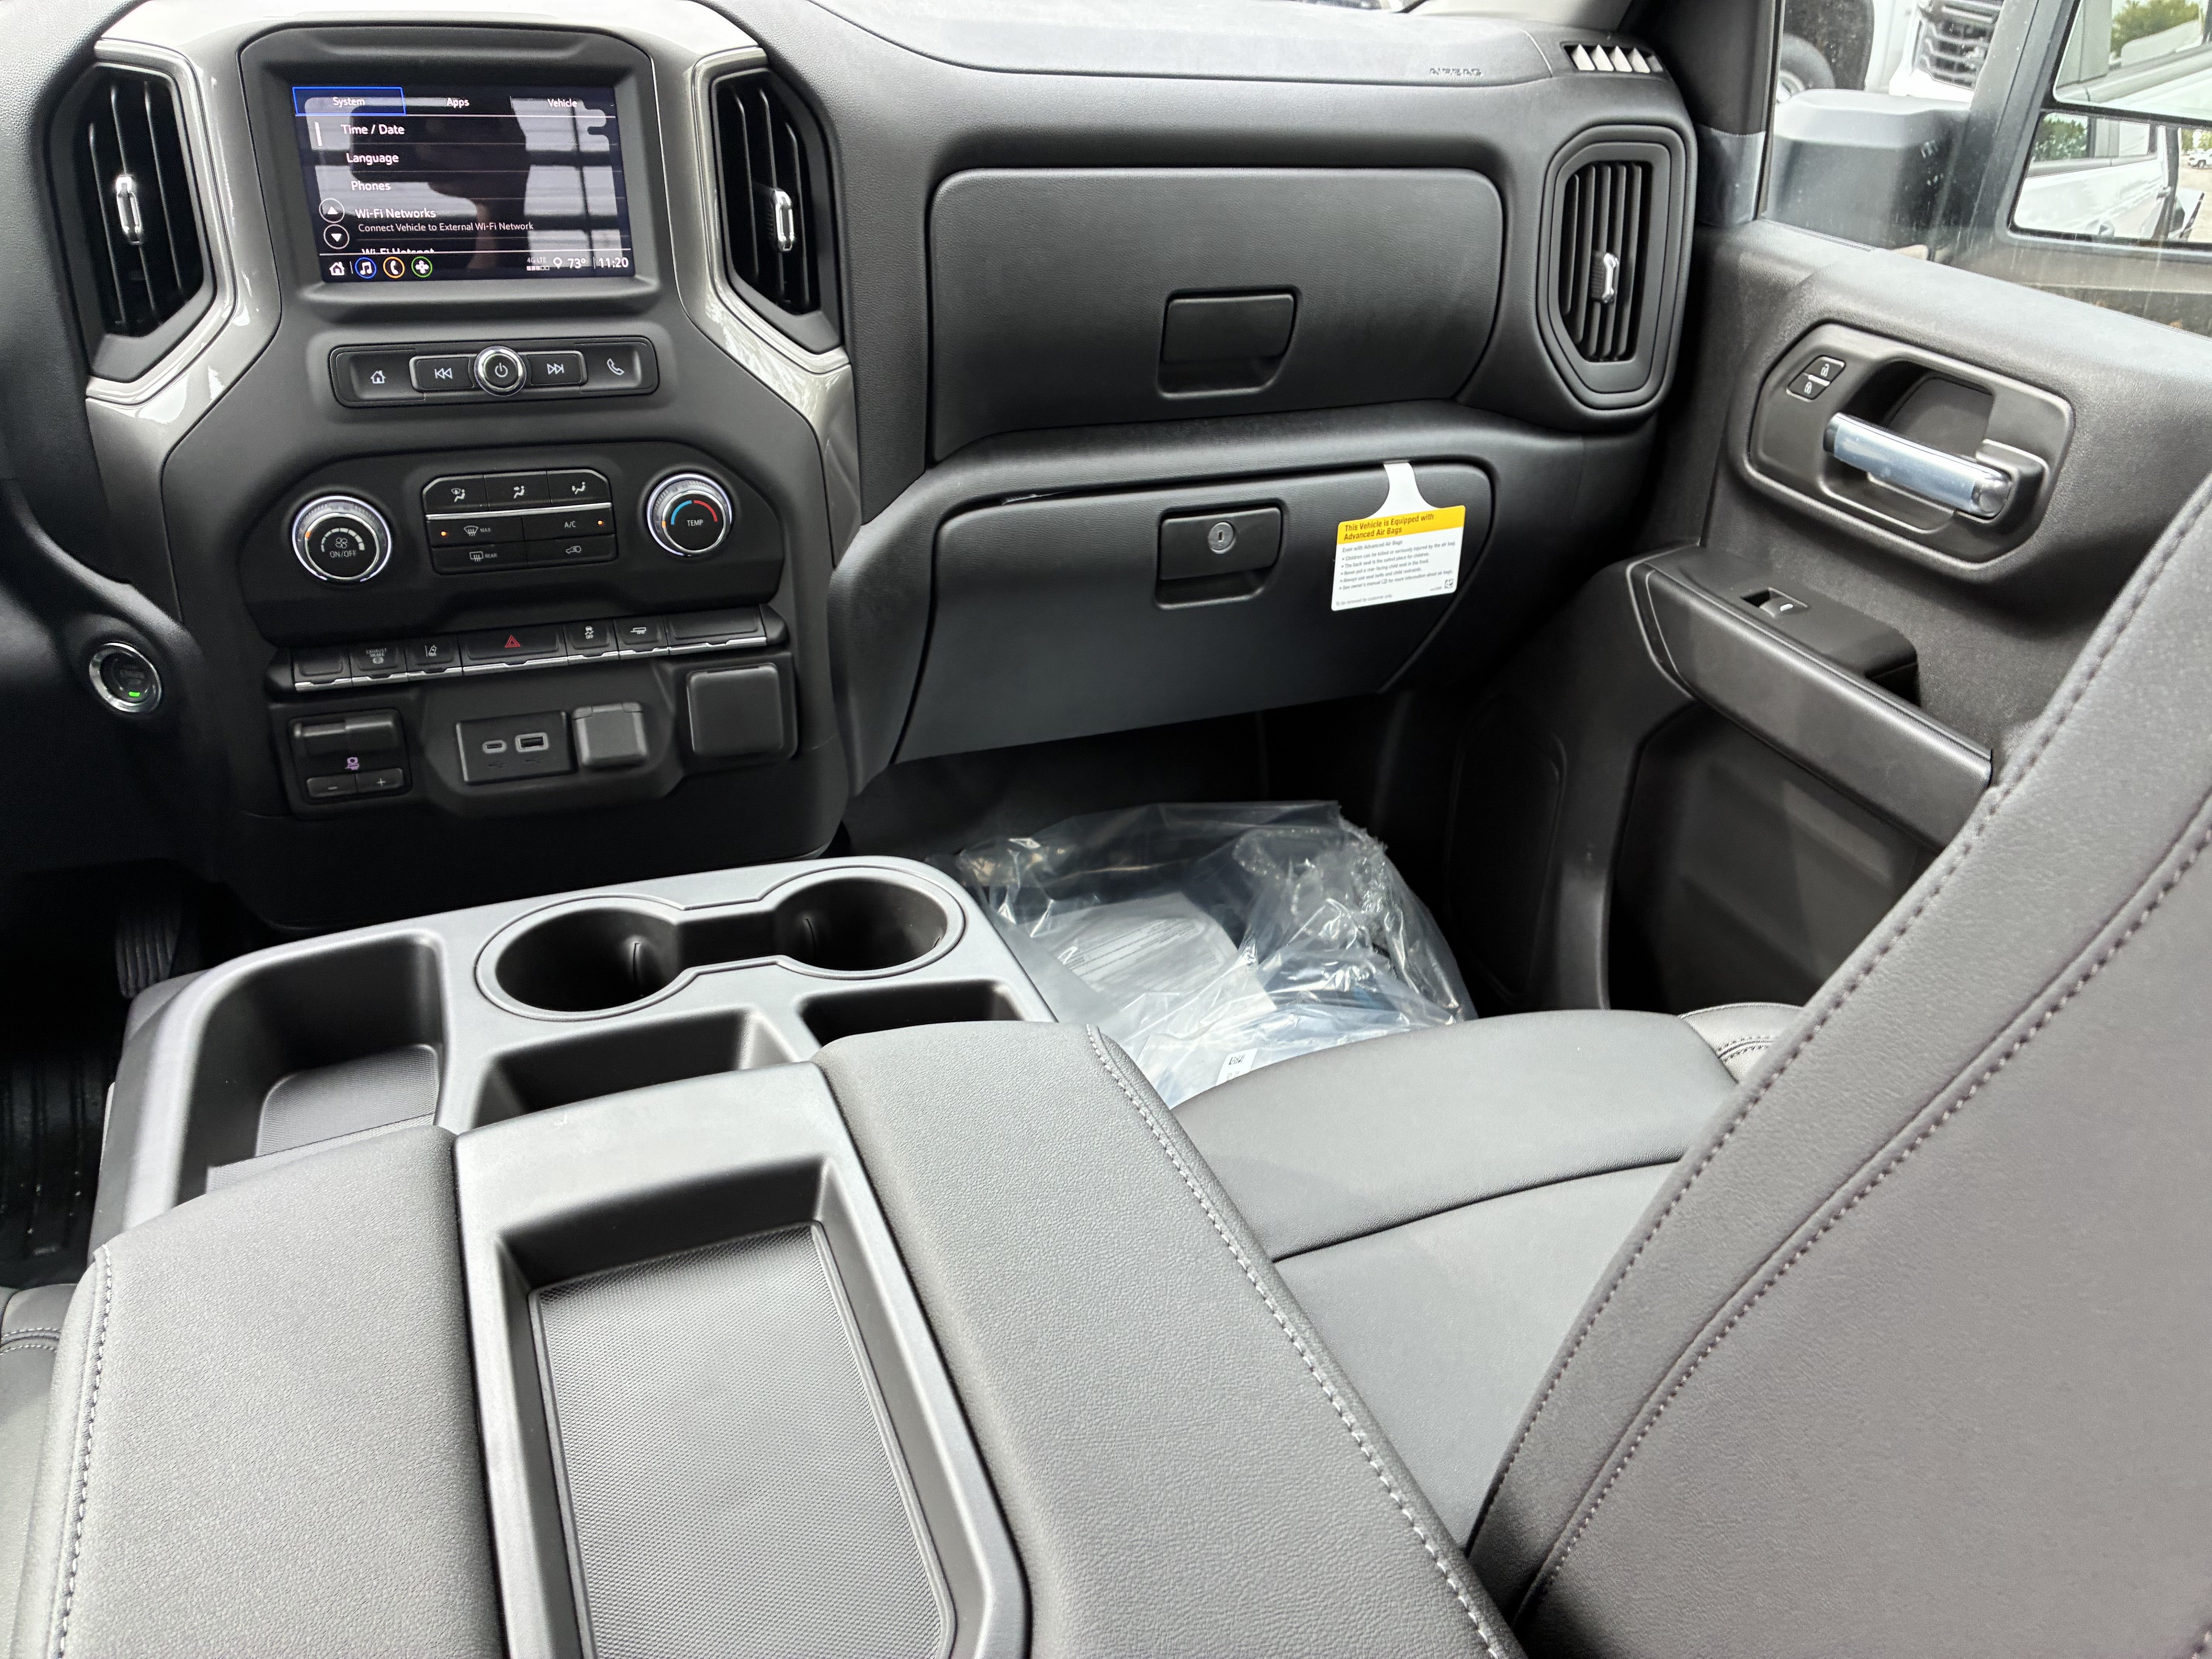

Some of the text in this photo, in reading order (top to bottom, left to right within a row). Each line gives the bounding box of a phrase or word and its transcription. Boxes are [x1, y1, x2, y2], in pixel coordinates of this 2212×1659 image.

[333, 97, 365, 108] System
[446, 98, 470, 108] Apps
[547, 98, 577, 107] Vehicle
[341, 124, 405, 134] Time / Date
[346, 153, 399, 165] Language
[351, 181, 391, 191] Phones
[355, 208, 436, 218] Wi-Fi Networks
[358, 223, 394, 232] Connect
[395, 223, 426, 232] Vehicle
[439, 222, 473, 231] External
[475, 222, 497, 230] Wi-Fi
[499, 222, 534, 230] Network
[568, 258, 586, 269] 73°
[599, 257, 629, 268] 11:20
[1360, 520, 1382, 530] Vehicle
[1391, 515, 1419, 526] Equipped
[1344, 530, 1374, 541] Advanced
[330, 550, 357, 558] ON/OFF
